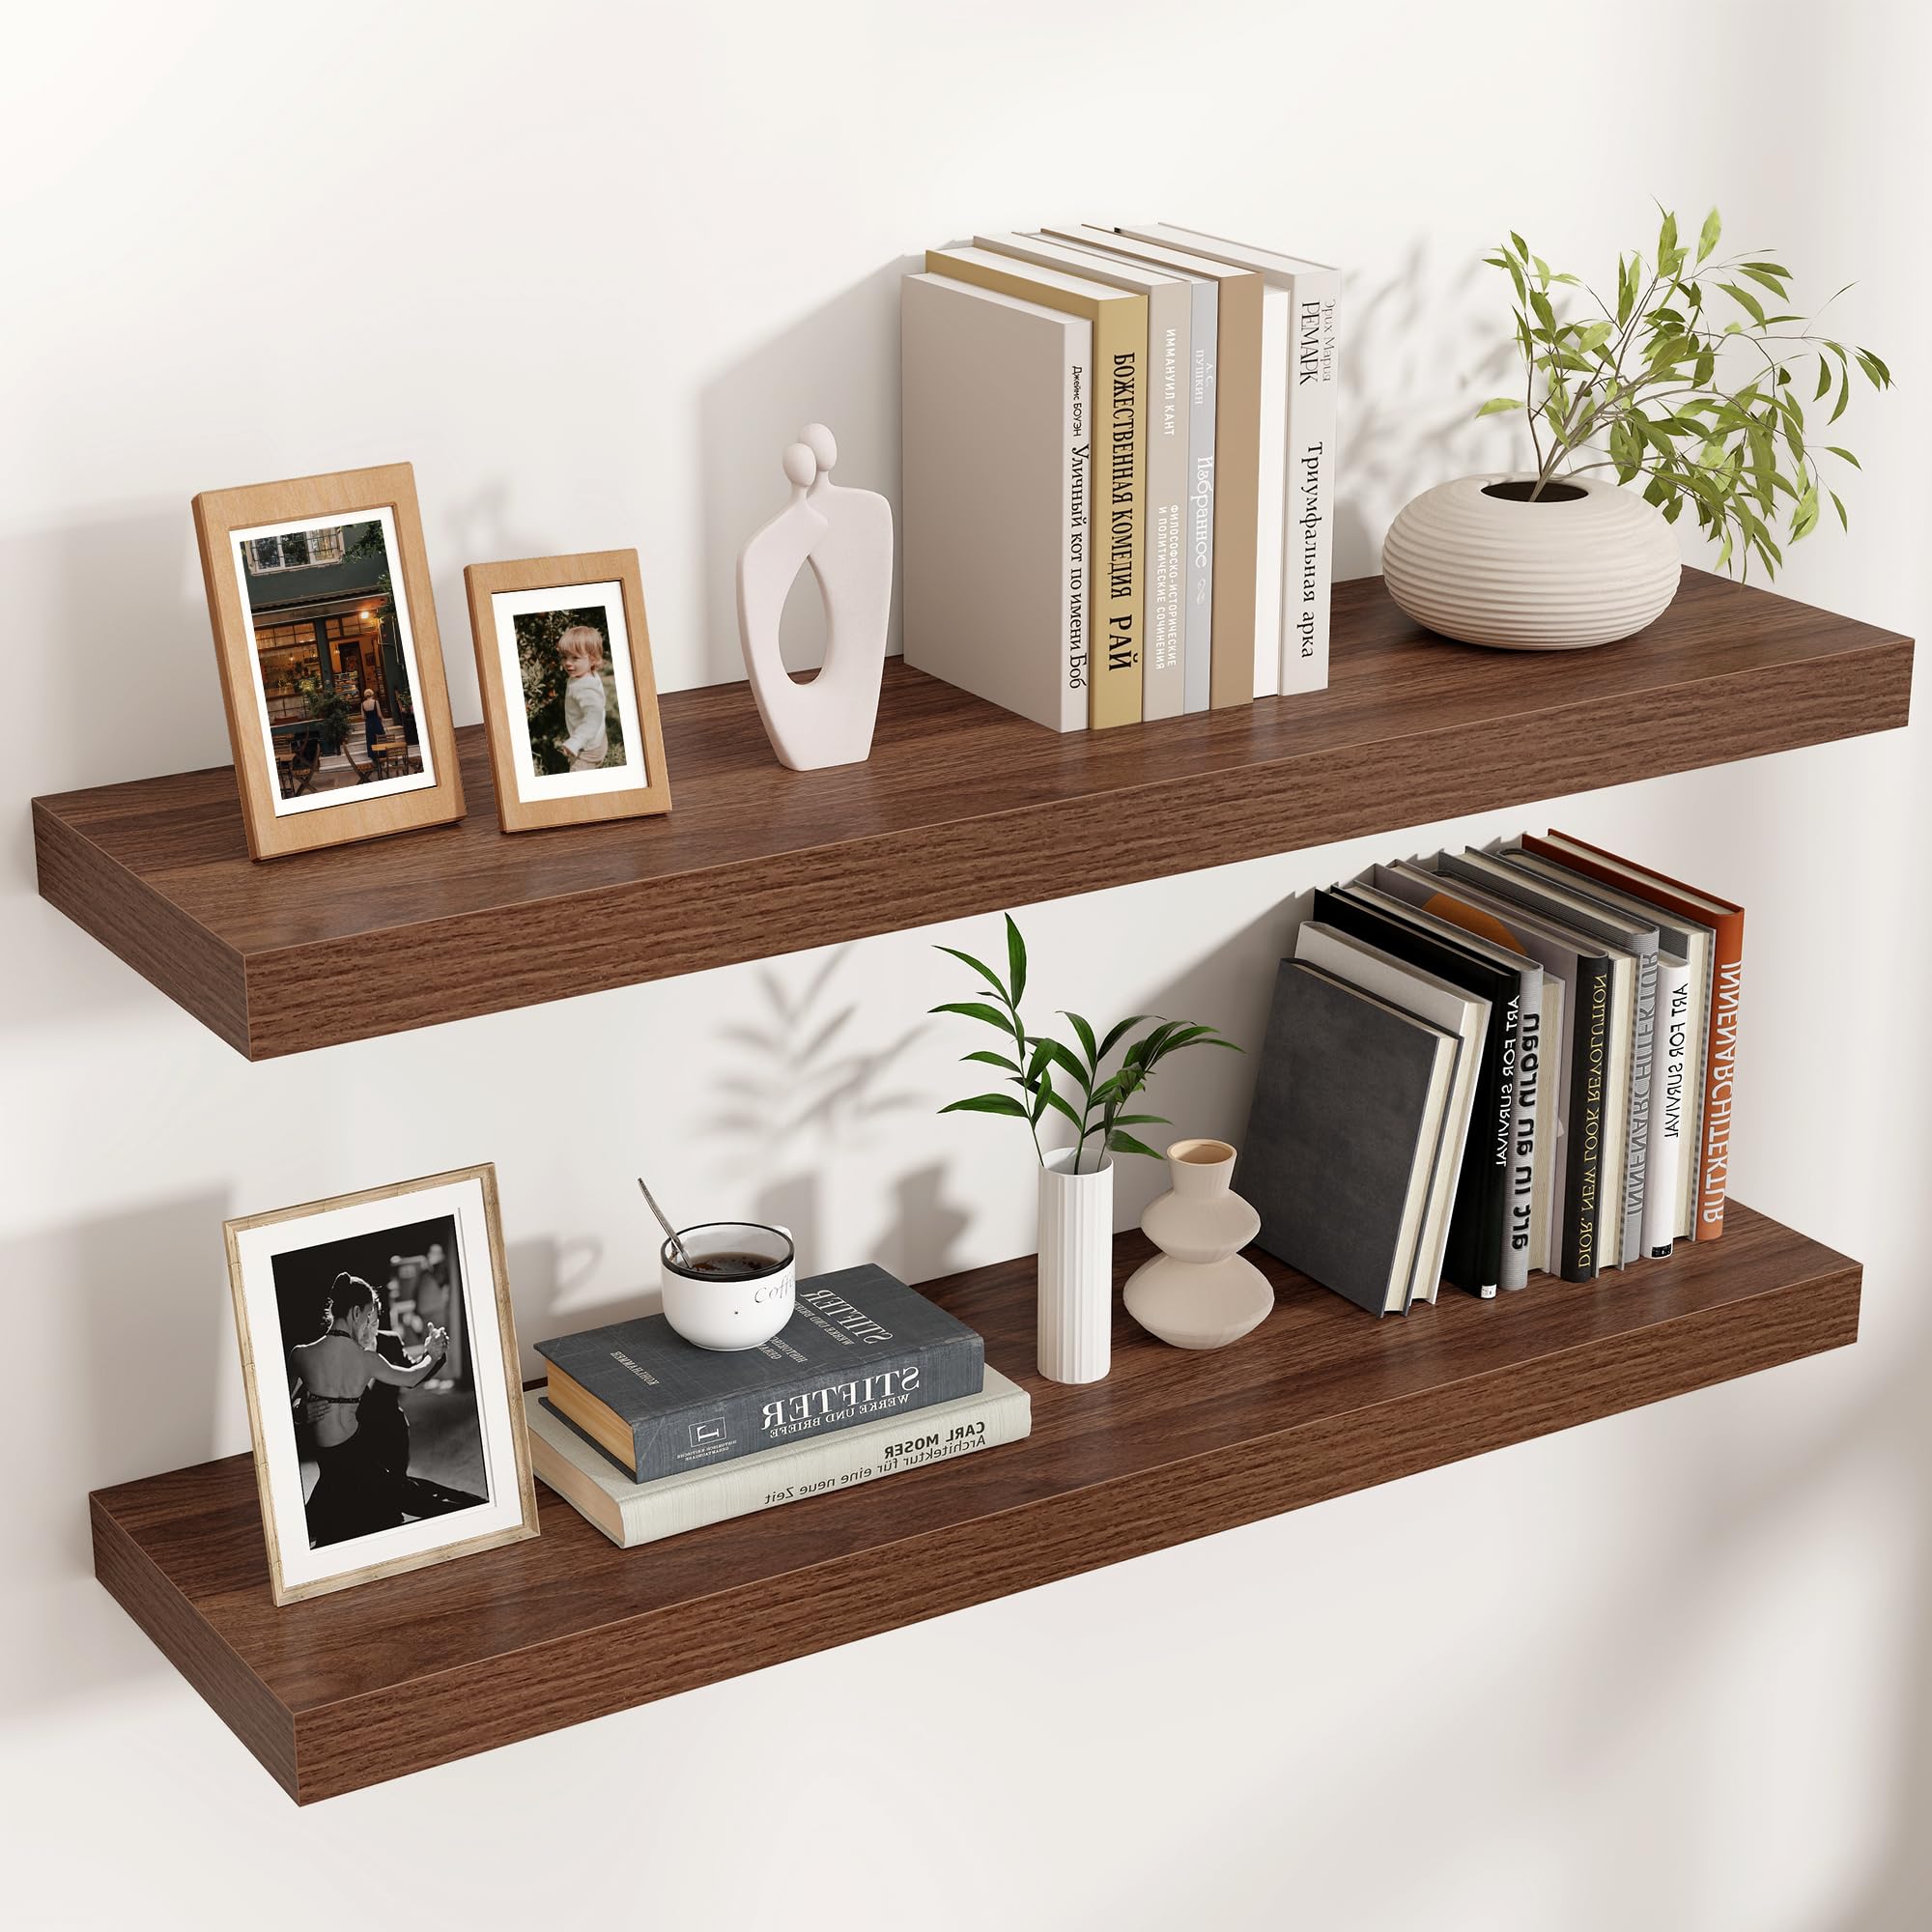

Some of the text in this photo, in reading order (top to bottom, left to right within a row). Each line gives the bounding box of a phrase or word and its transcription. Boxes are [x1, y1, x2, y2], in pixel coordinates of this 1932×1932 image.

[1163, 328, 1176, 436] ИММАНУИЛ КАНТ
[1194, 349, 1205, 405] ПУШКИН
[1299, 301, 1320, 385] РЕМАРК
[1320, 337, 1335, 382] Мария
[1071, 366, 1082, 437] Джеймс БОУЭН
[1107, 353, 1138, 670] БОЖЕСТВЕННАЯ КОМЕДИЯ РАЙ
[1190, 456, 1213, 568] Избранное
[1297, 441, 1322, 658] Триумфальная арка
[1069, 444, 1090, 689] Уличный кот по имени Боб
[1156, 518, 1167, 603] ПОЛИТИЧЕСКИЕ
[1167, 504, 1179, 666] ФИЛОСОФСКО-ИСТОРИЧЕСКИЕ
[1155, 607, 1165, 669] СОЧИНЕНИЯ
